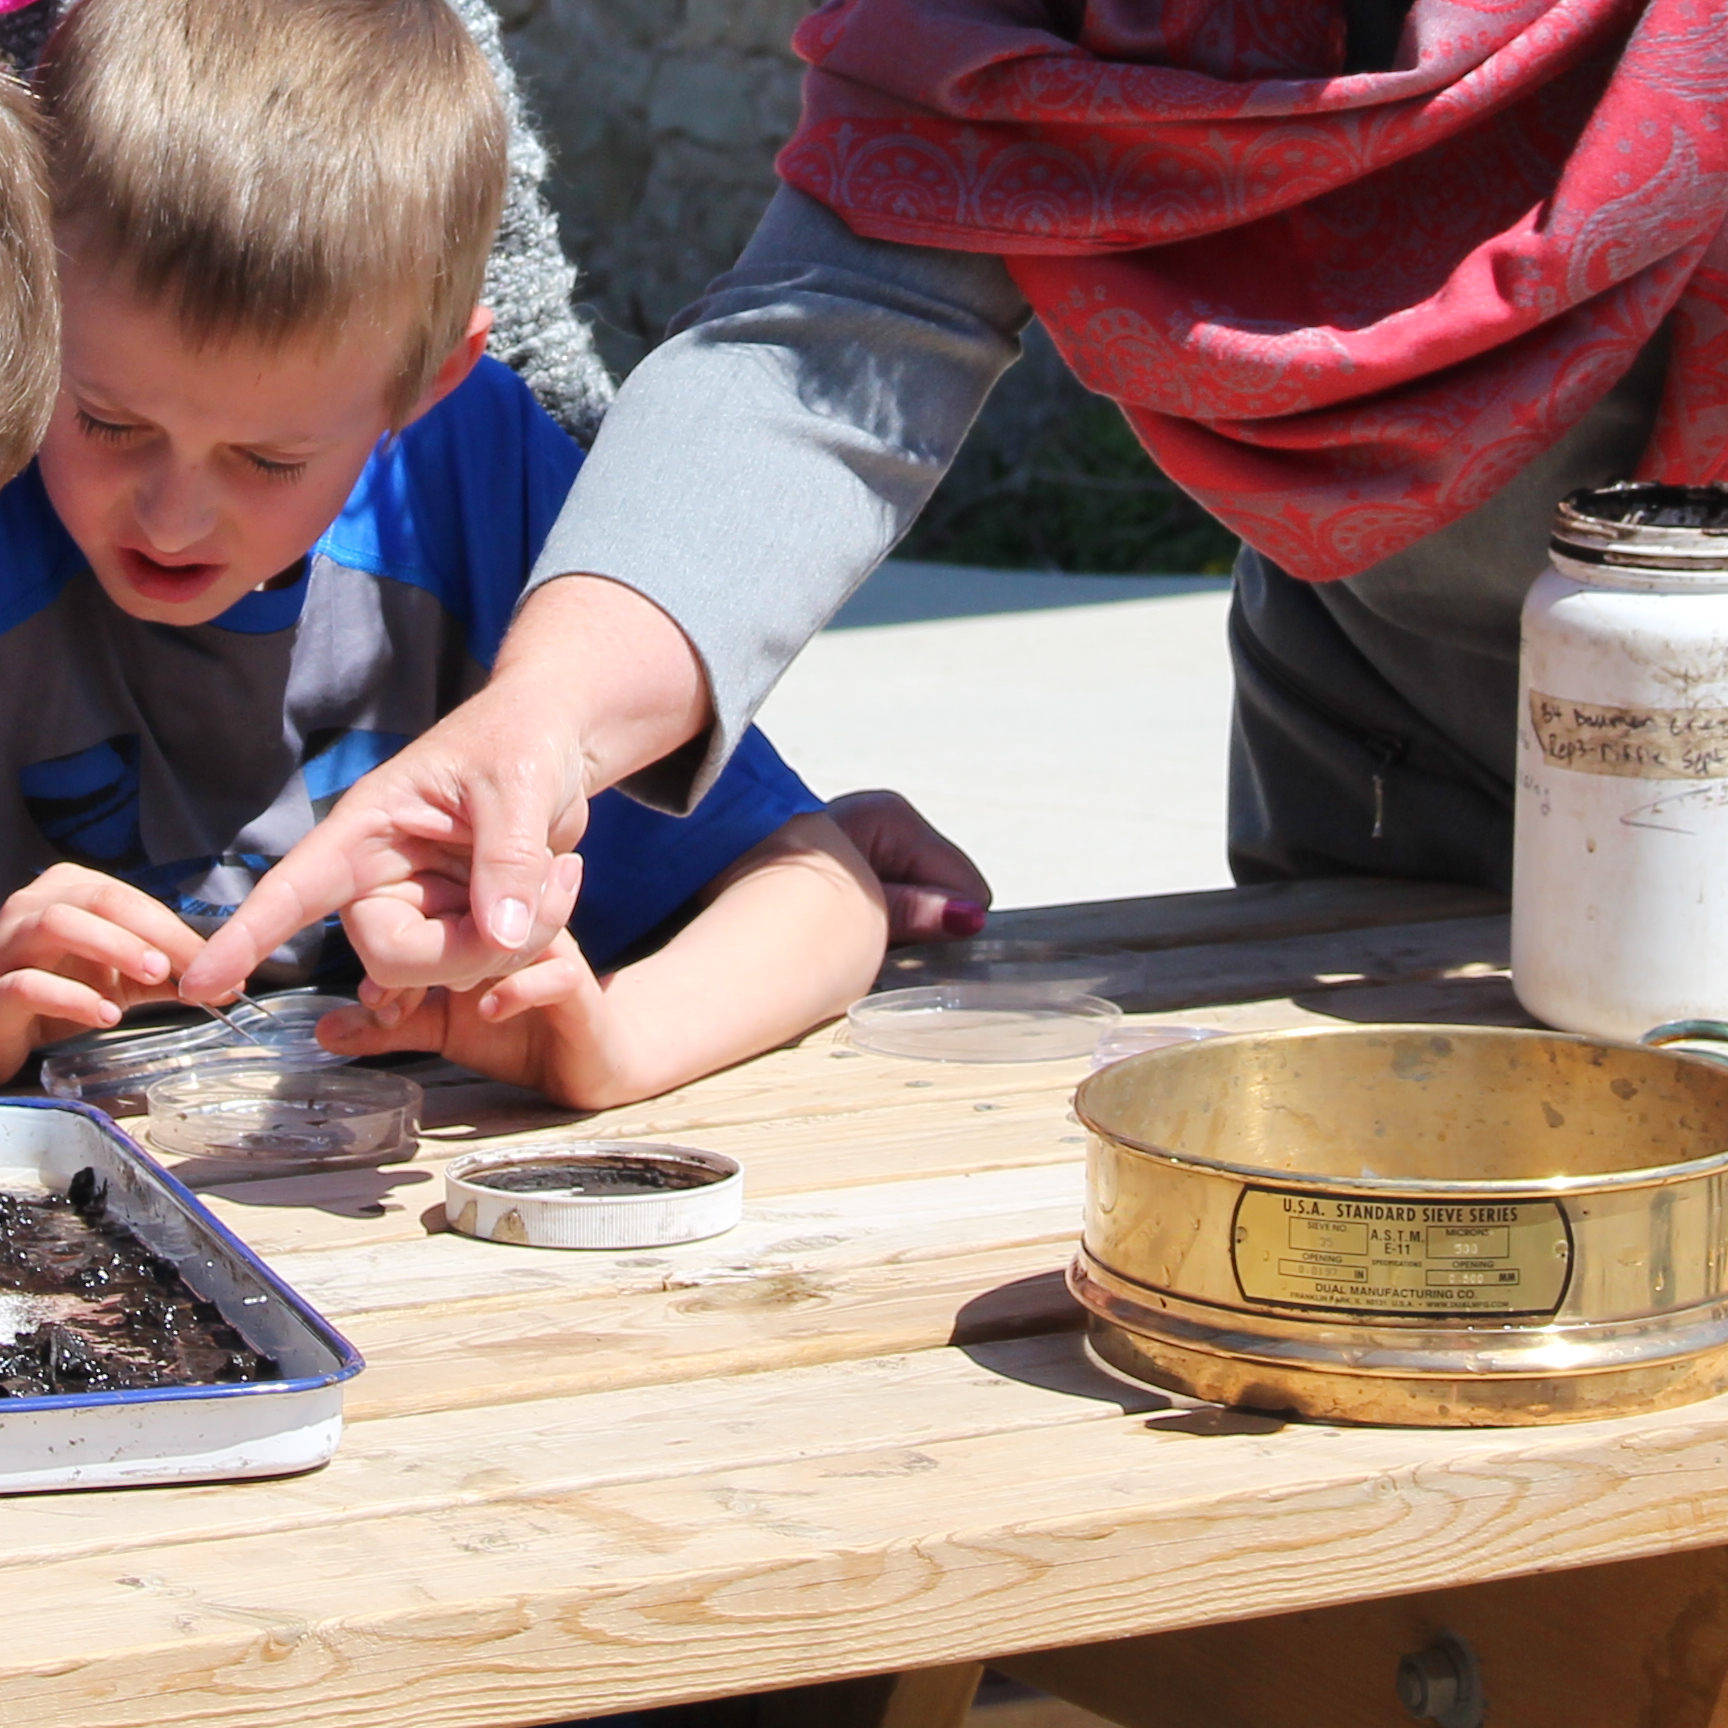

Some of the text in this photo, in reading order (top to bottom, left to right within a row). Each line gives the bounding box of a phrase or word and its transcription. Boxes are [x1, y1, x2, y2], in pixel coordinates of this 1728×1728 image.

[1283, 1198, 1519, 1223] U.S.A. STANDARD SIEVE SERIES
[1306, 1221, 1330, 1231] SIEVE
[1370, 1229, 1425, 1243] A.S.T.M.
[1384, 1242, 1410, 1255] E-11
[1302, 1252, 1343, 1263] OPENING
[1451, 1260, 1495, 1269] OPENING
[1354, 1269, 1365, 1279] IN
[1498, 1272, 1516, 1282] MM
[1315, 1283, 1478, 1299] DUAL MANUFACTURING CO.
[1290, 1292, 1328, 1302] FRANKLIN
